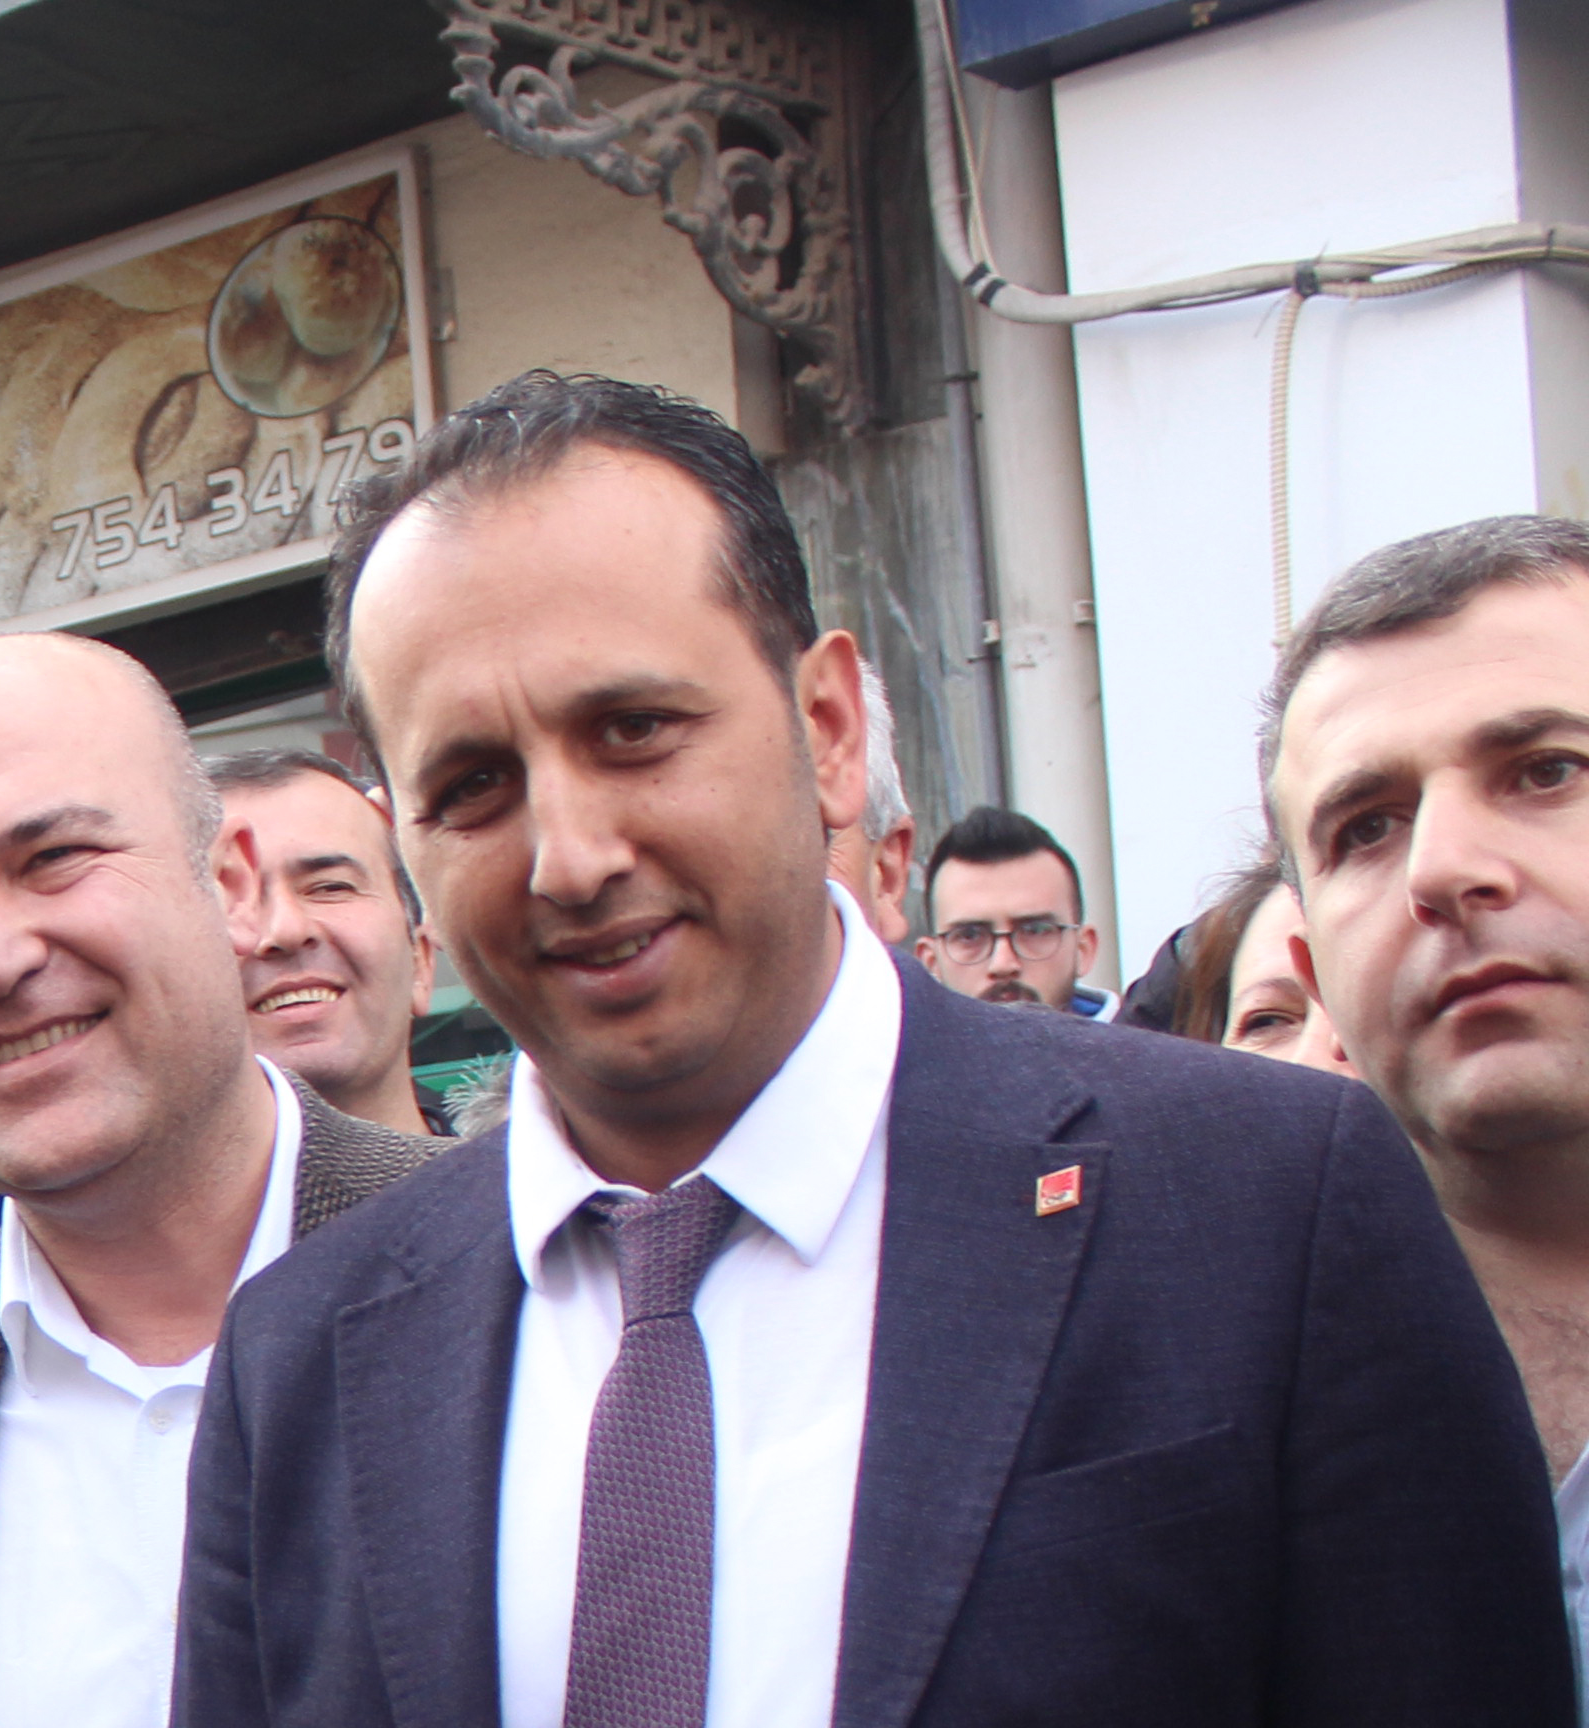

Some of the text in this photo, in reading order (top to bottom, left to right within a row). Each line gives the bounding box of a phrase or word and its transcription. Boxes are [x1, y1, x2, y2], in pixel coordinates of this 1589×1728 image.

[51, 416, 417, 581] 754 34 79
